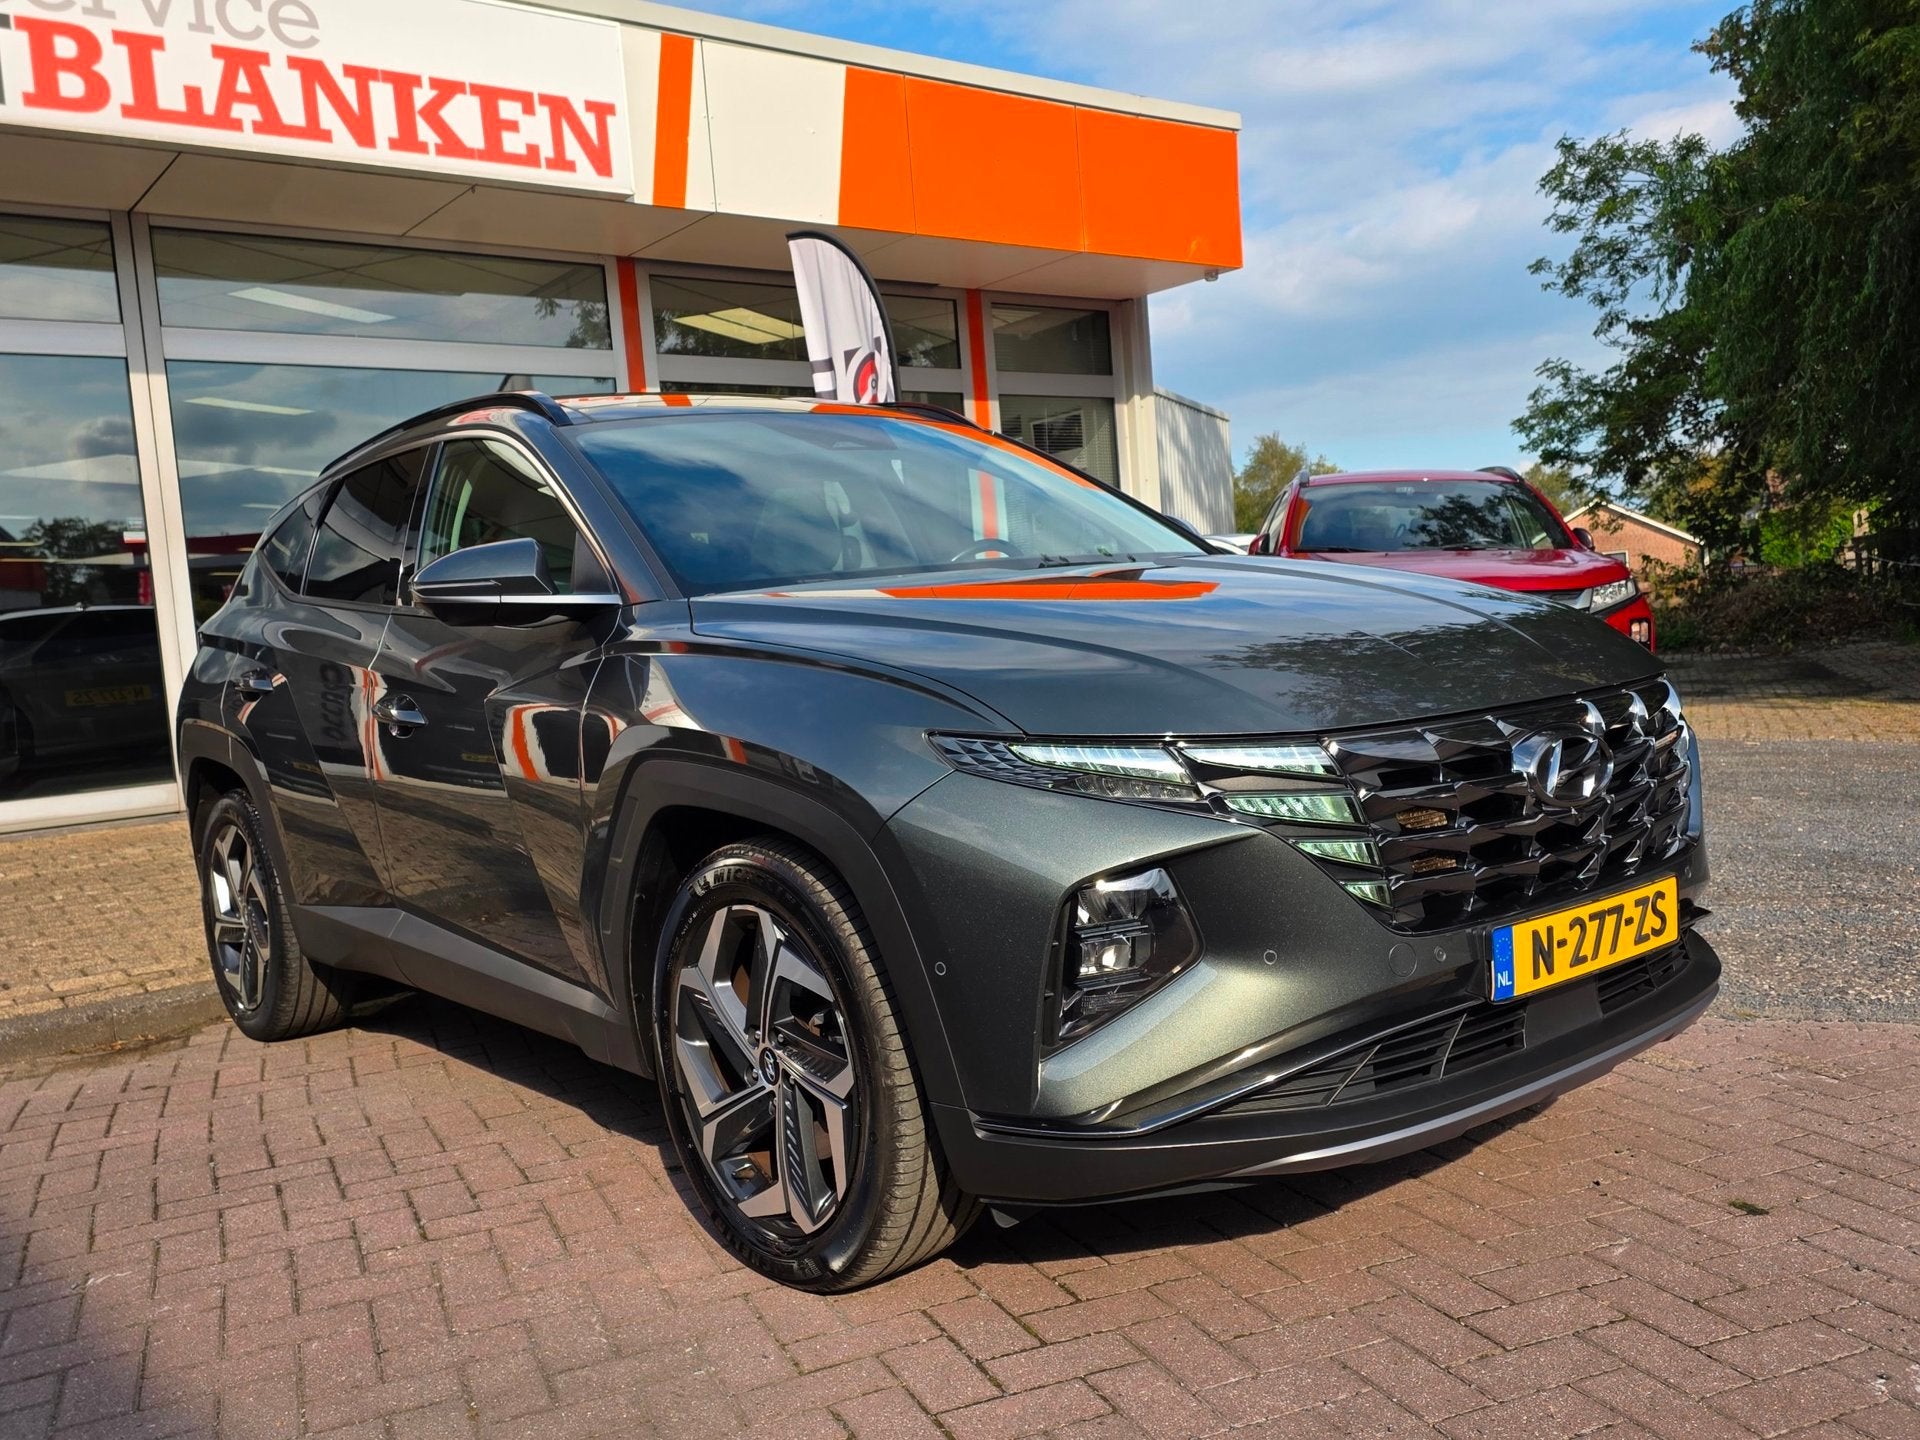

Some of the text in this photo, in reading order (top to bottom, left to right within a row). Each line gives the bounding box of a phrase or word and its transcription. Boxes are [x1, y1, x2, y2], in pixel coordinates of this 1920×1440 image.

[13, 15, 616, 178] BLANKEN
[1497, 970, 1512, 988] NL
[1532, 890, 1667, 980] N-277-ZS
